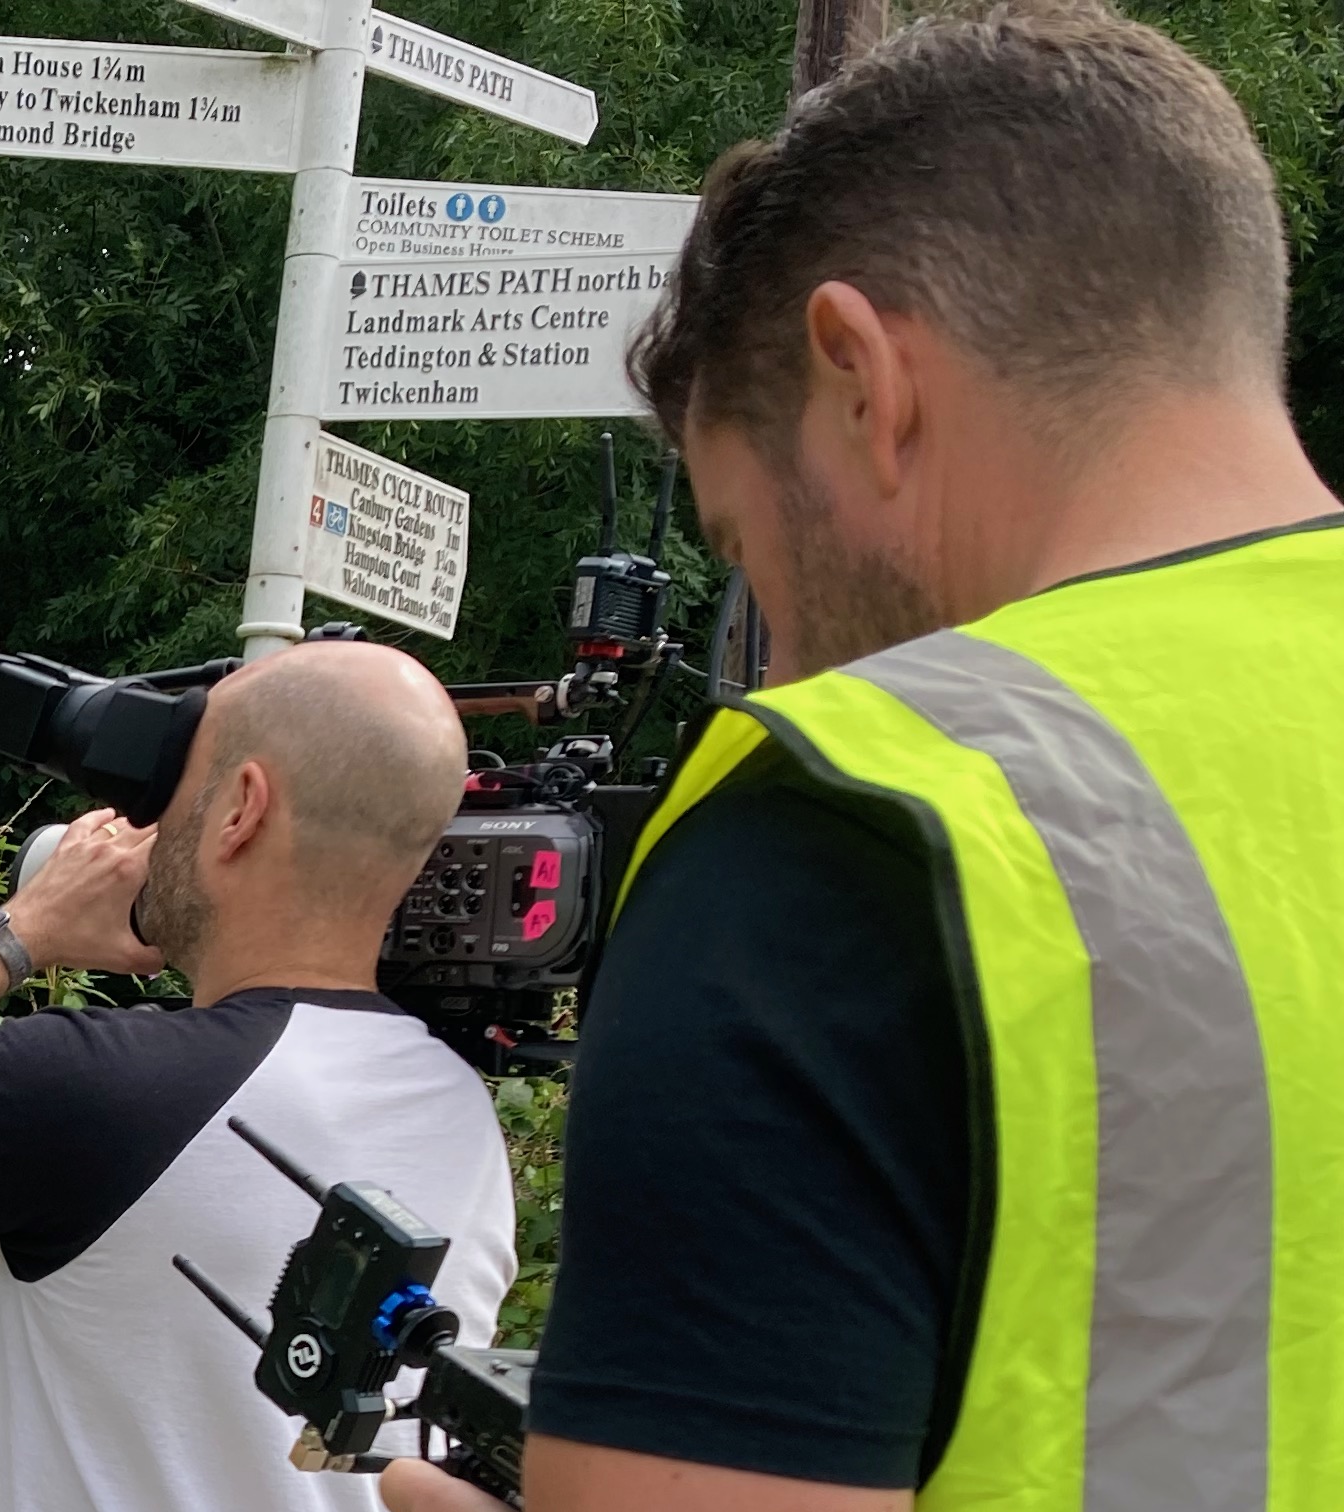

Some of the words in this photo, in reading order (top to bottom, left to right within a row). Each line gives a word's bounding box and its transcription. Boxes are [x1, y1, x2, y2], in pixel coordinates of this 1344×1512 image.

[12, 51, 82, 78] House
[389, 33, 465, 83] THAMES
[468, 63, 514, 102] PATH
[16, 88, 37, 110] to
[41, 88, 180, 119] Twickenham
[63, 122, 136, 153] Bridge
[361, 190, 438, 218] Toilets
[356, 236, 395, 254] Open
[400, 239, 465, 256] Business
[357, 220, 473, 241] COMMUNITY
[478, 226, 544, 244] TOILET
[547, 231, 625, 249] SCHEME
[371, 271, 491, 299] THAMES
[497, 267, 574, 295] PATH
[577, 265, 641, 293] north
[345, 309, 465, 334] Landmark
[470, 307, 523, 332] Arts
[531, 304, 610, 329] Centre
[343, 345, 471, 373] Teddington
[478, 343, 497, 366] &
[502, 342, 590, 366] Station
[338, 381, 479, 405] Twickenham
[326, 448, 380, 490] THAMES
[382, 472, 422, 508] CYCLE
[425, 489, 464, 526] ROUTE
[312, 500, 321, 522] 4
[350, 487, 393, 529] Canbury
[395, 505, 436, 541] Gardens
[347, 513, 392, 551] Kingston
[393, 531, 427, 567] Bridge
[345, 541, 390, 579] Hampton
[392, 561, 421, 590] Court
[343, 568, 377, 602] Walton
[390, 585, 428, 620] Thames
[479, 821, 537, 830] SONY
